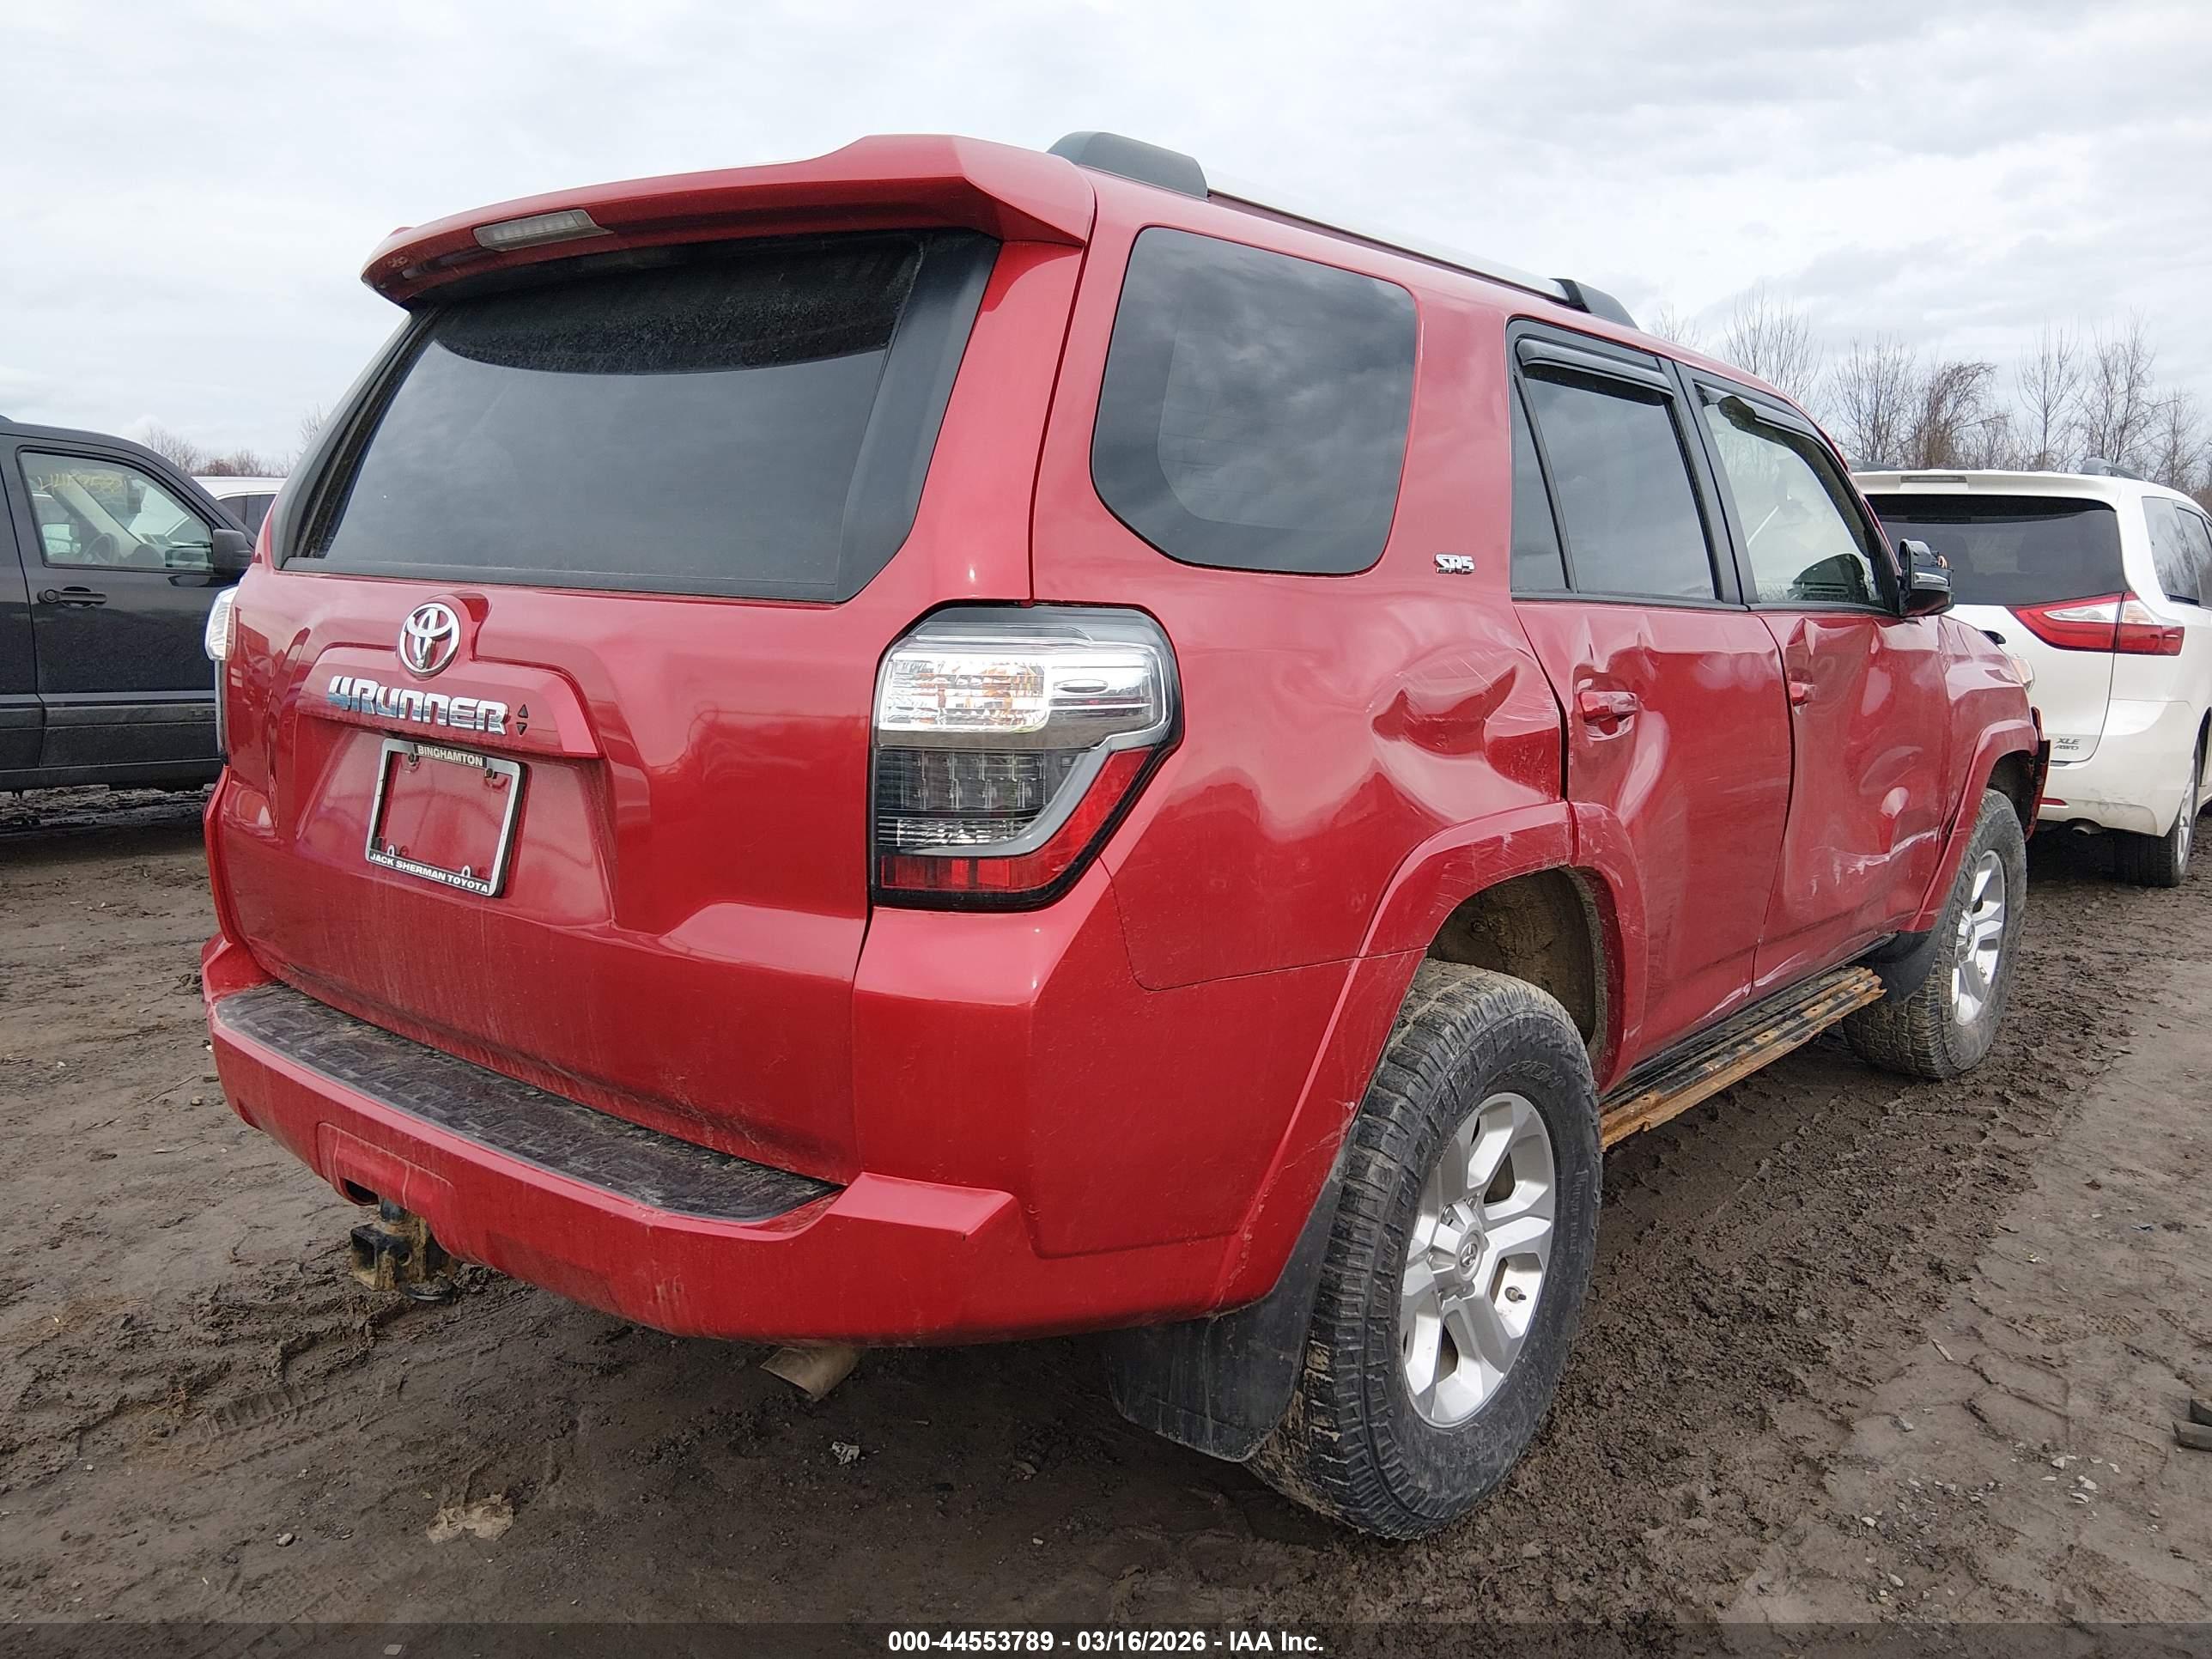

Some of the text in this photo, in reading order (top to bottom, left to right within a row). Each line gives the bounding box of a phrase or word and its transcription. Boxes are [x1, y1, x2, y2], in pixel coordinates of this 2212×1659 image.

[1435, 554, 1474, 573] SR5
[326, 674, 510, 736] 4RUNNER
[416, 744, 483, 767] BINGHAMTON
[369, 853, 489, 893] JACK SHERMAN TOYOTA
